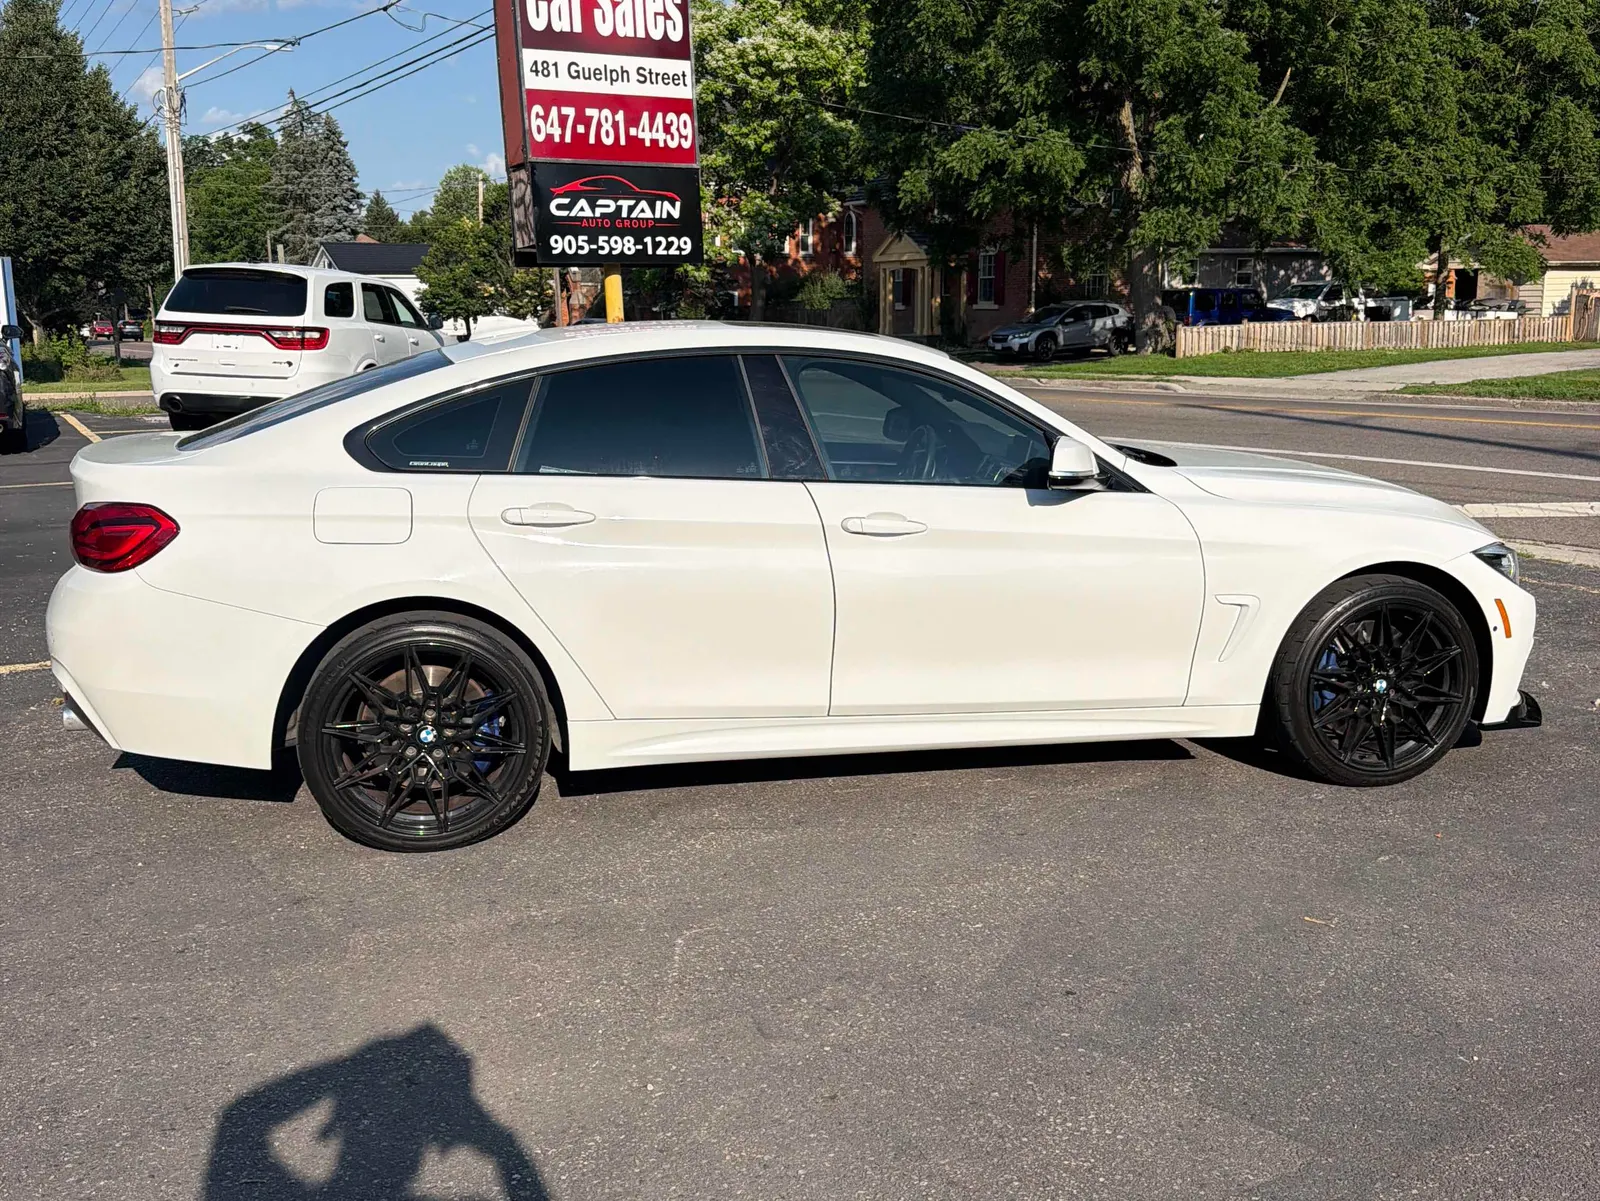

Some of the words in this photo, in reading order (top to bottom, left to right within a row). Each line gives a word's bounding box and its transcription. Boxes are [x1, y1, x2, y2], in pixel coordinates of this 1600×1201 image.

[530, 60, 559, 78] 481
[567, 61, 630, 86] Guelph
[636, 66, 688, 87] Street
[530, 104, 693, 149] 647-781-4439
[550, 198, 681, 219] CAPTAIN
[581, 219, 611, 228] AUTO
[615, 219, 655, 228] GROUP
[550, 235, 692, 255] 905-598-1229
